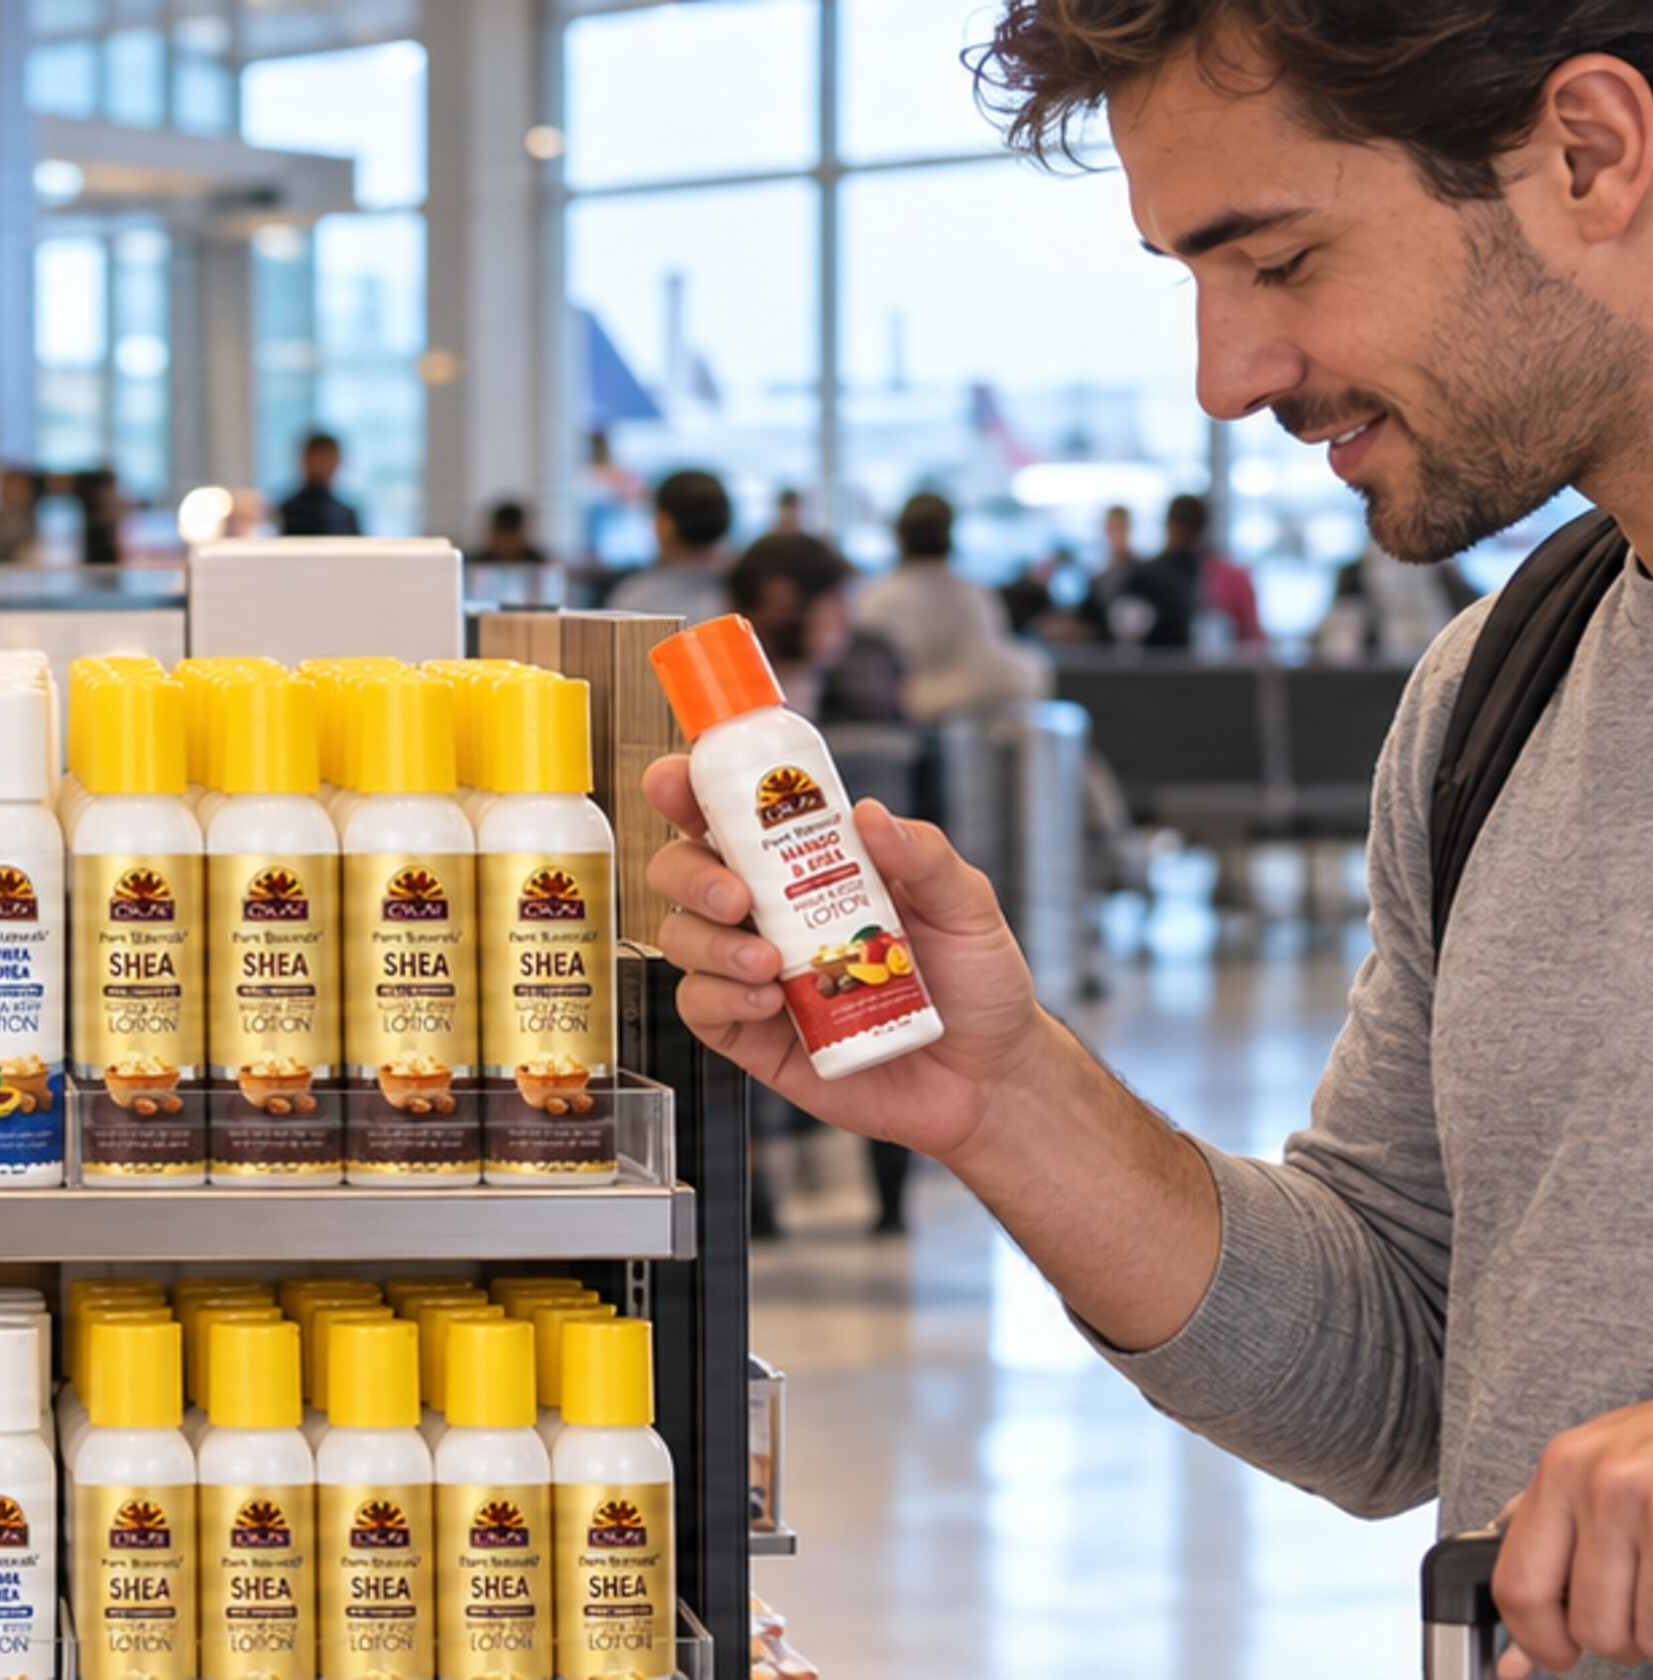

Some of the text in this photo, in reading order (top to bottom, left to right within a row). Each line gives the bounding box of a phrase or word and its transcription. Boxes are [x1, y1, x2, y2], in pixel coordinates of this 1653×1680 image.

[110, 952, 175, 978] SHEA
[243, 952, 309, 978] SHEA
[384, 952, 449, 978] SHEA
[520, 952, 585, 978] SHEA
[110, 1576, 171, 1600] SHEA
[231, 1576, 293, 1600] SHEA
[351, 1576, 411, 1600] SHEA
[471, 1576, 530, 1600] SHEA
[589, 1576, 647, 1600] SHEA
